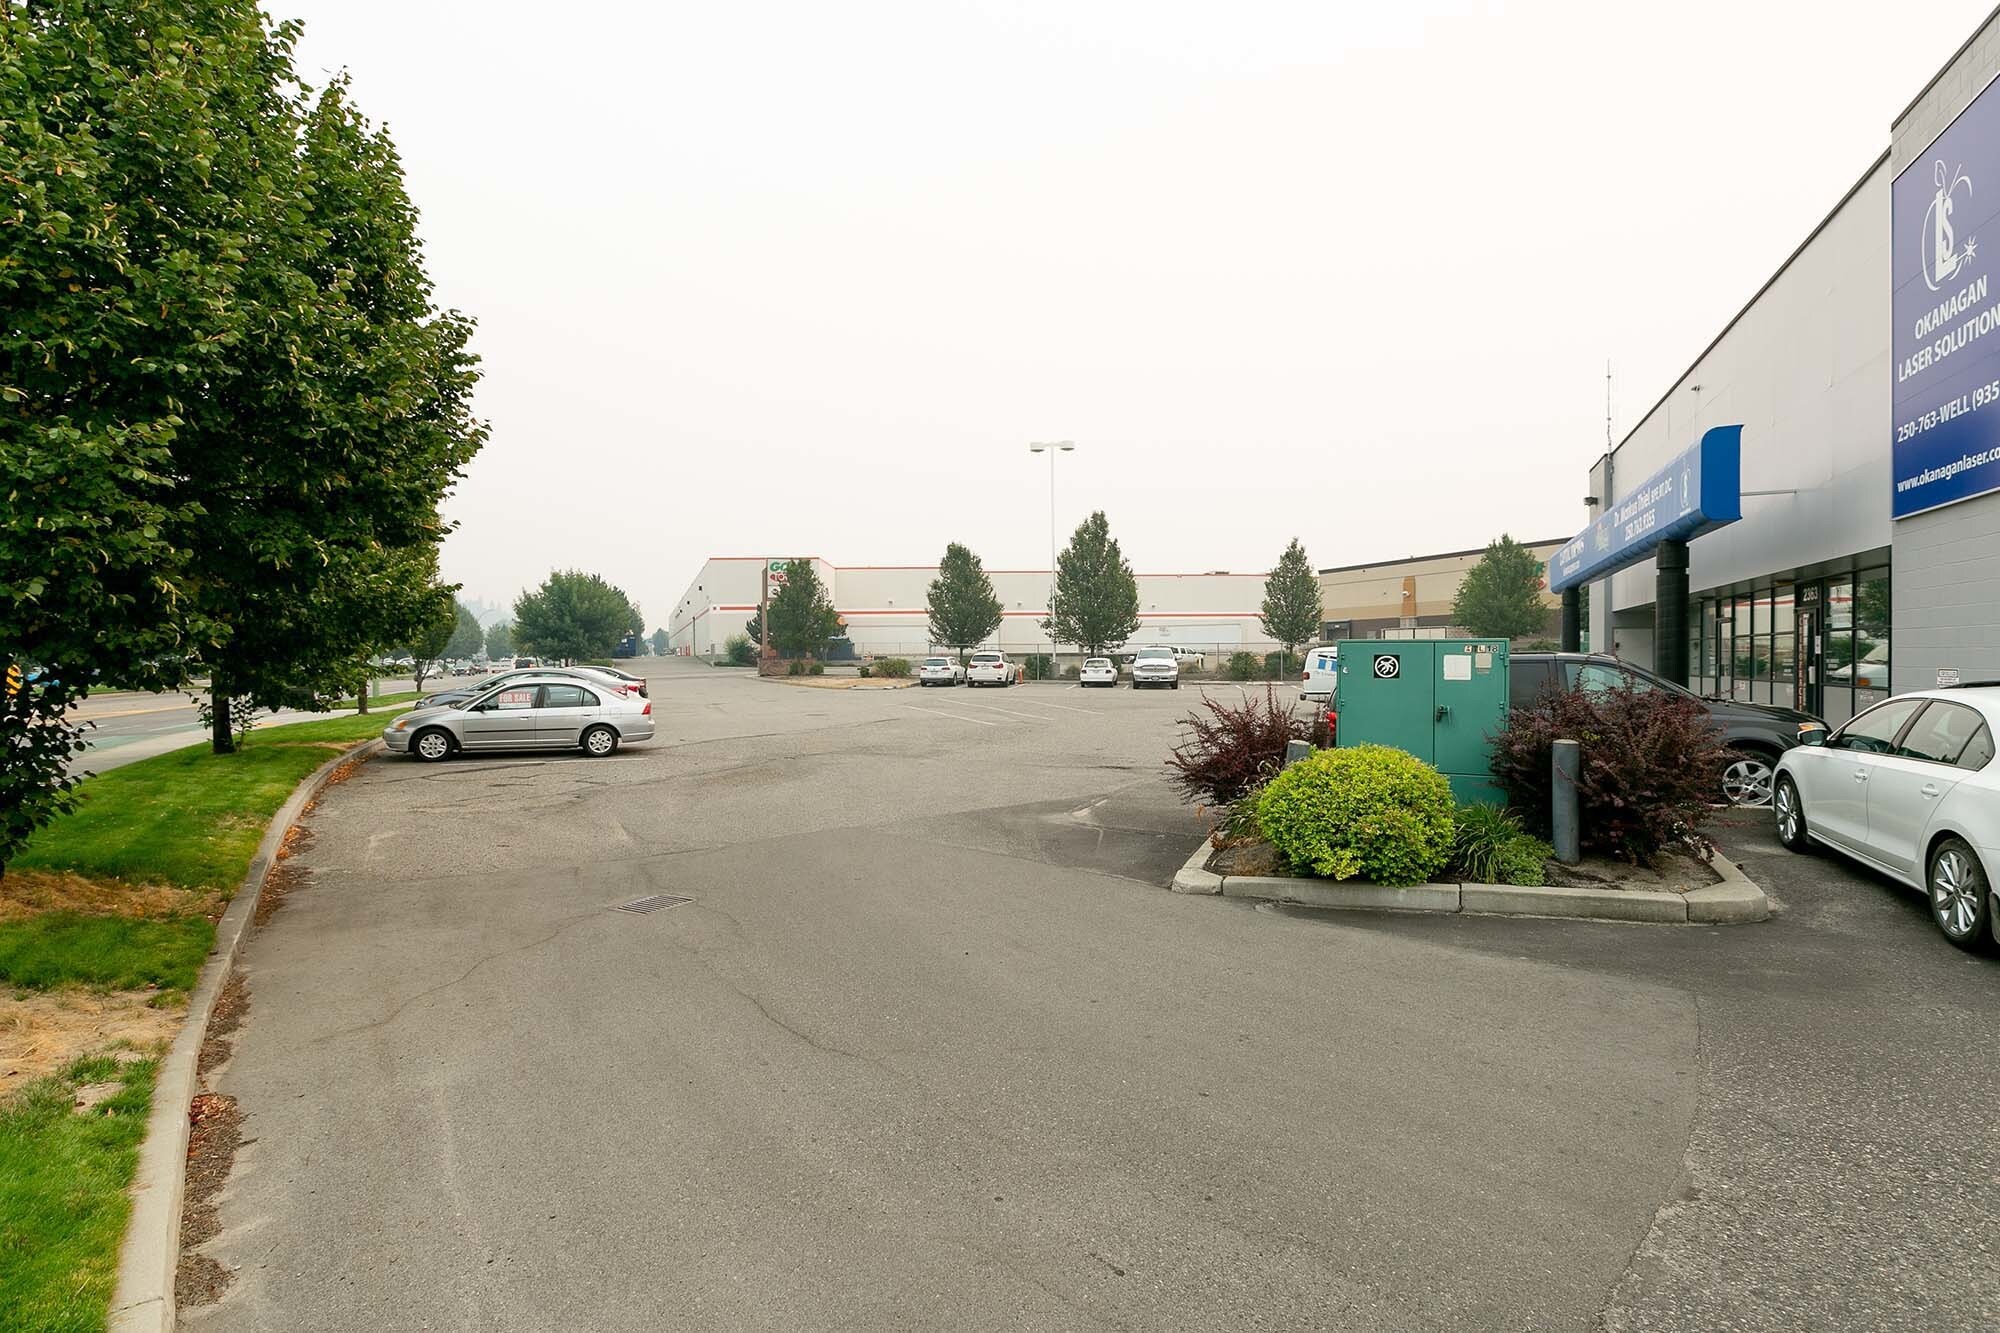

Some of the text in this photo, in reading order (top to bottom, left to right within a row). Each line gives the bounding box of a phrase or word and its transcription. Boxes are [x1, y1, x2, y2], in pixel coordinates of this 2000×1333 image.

[1914, 274, 1987, 339] OKANAGAN
[1898, 346, 1933, 383] LASER
[1897, 395, 1970, 443] 250-763-WELL
[499, 691, 531, 703] FOR SALE
